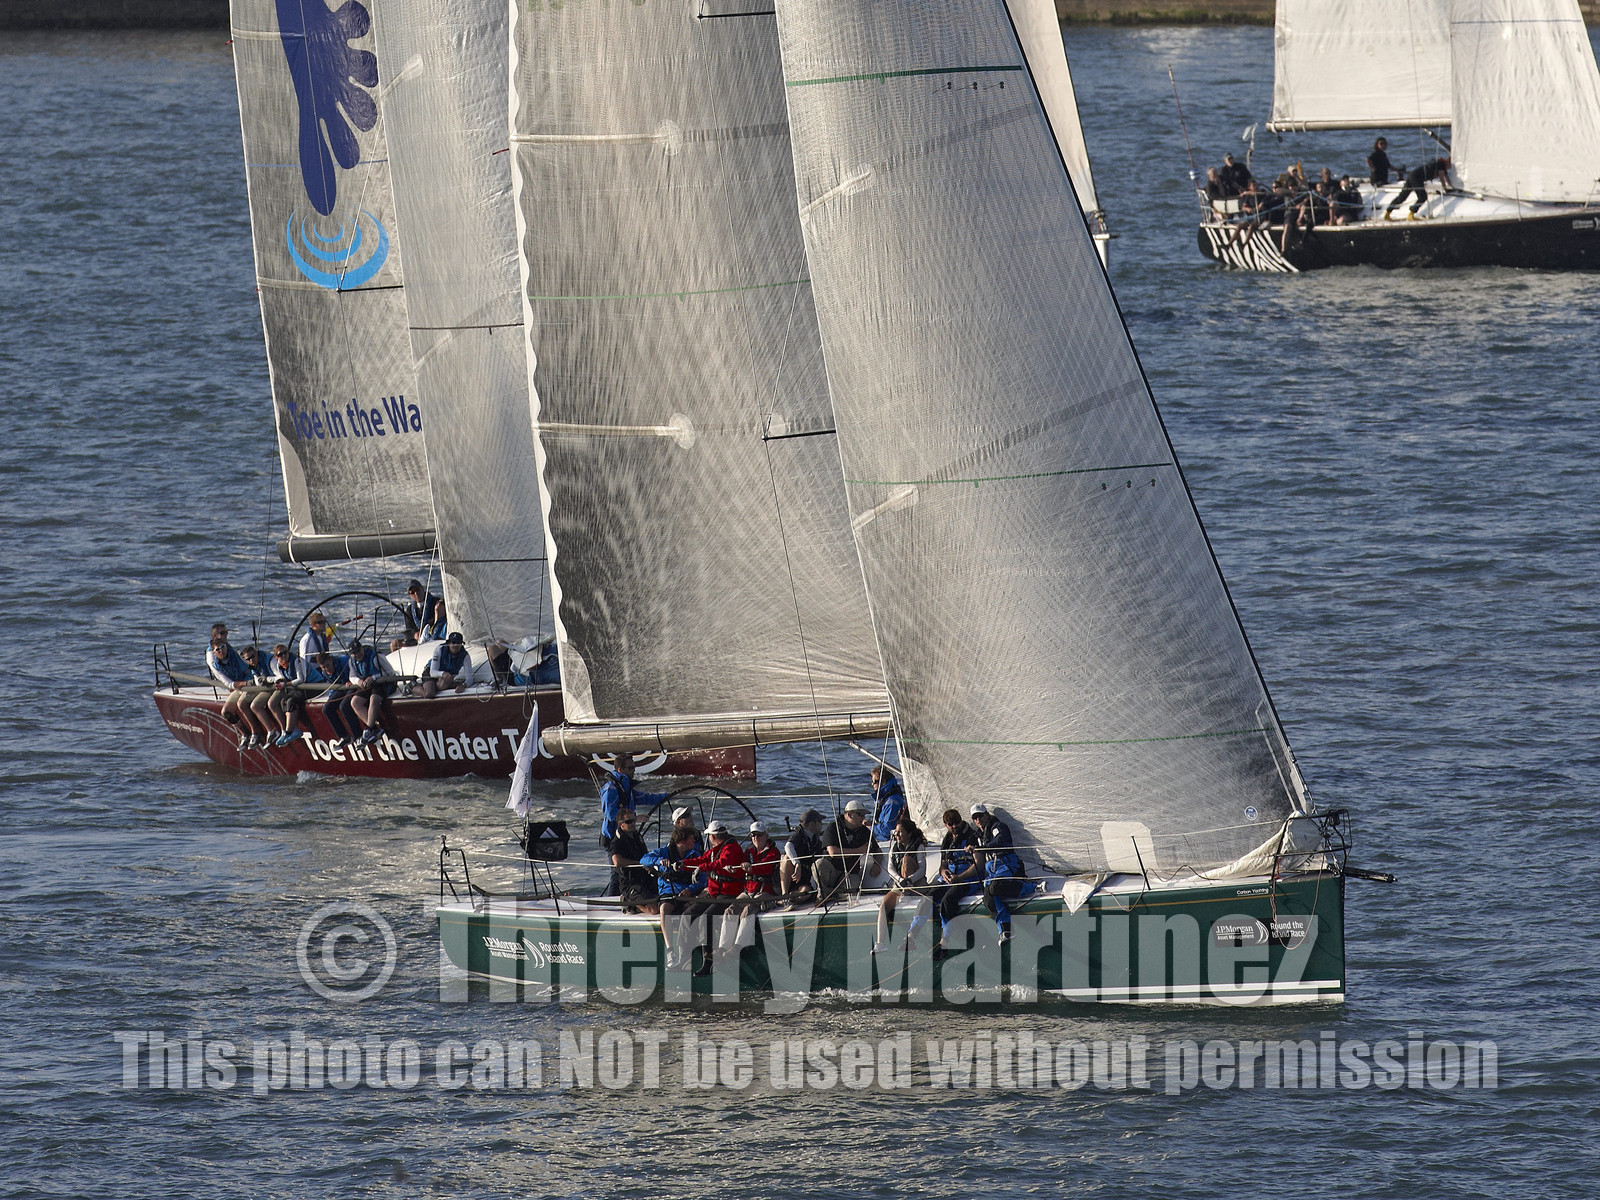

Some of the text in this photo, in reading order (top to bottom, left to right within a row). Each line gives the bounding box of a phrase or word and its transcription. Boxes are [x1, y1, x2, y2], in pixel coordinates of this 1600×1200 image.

[287, 401, 325, 440] Toe
[322, 400, 348, 438] in
[346, 398, 386, 437] the
[301, 731, 347, 762] Toe
[375, 731, 418, 761] the
[416, 729, 499, 761] Water
[1270, 921, 1304, 930] Round the
[1291, 930, 1305, 938] Race
[539, 941, 579, 953] Round the
[545, 953, 585, 965] Island Race
